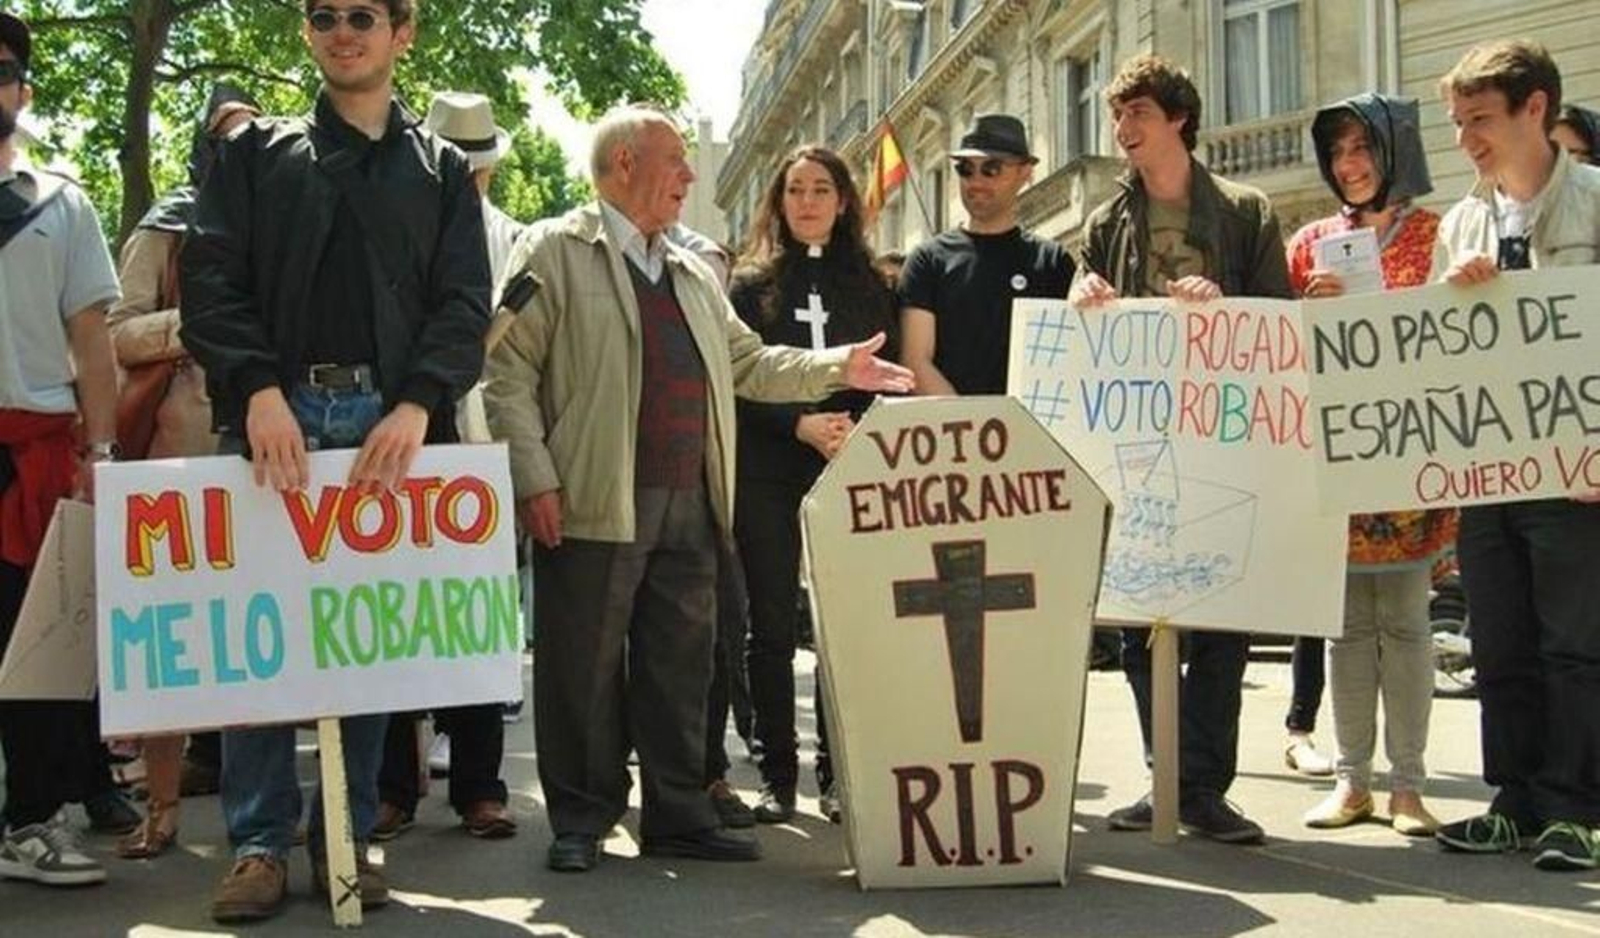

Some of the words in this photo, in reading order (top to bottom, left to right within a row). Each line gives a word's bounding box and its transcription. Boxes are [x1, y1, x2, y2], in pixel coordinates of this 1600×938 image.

[1184, 310, 1307, 374] ROGAD
[1313, 317, 1381, 374] NO
[1391, 301, 1500, 364] PASO
[1516, 294, 1582, 344] DE
[867, 418, 1008, 470] VOTO
[1320, 384, 1514, 463] ESPAÑA
[125, 487, 235, 577] MI
[281, 475, 499, 563] VOTO
[846, 469, 1072, 534] EMIGRANTE
[110, 602, 199, 692] ME
[209, 592, 285, 684] LO
[309, 573, 519, 669] ROBARON
[891, 758, 1046, 869] R.I.P.
